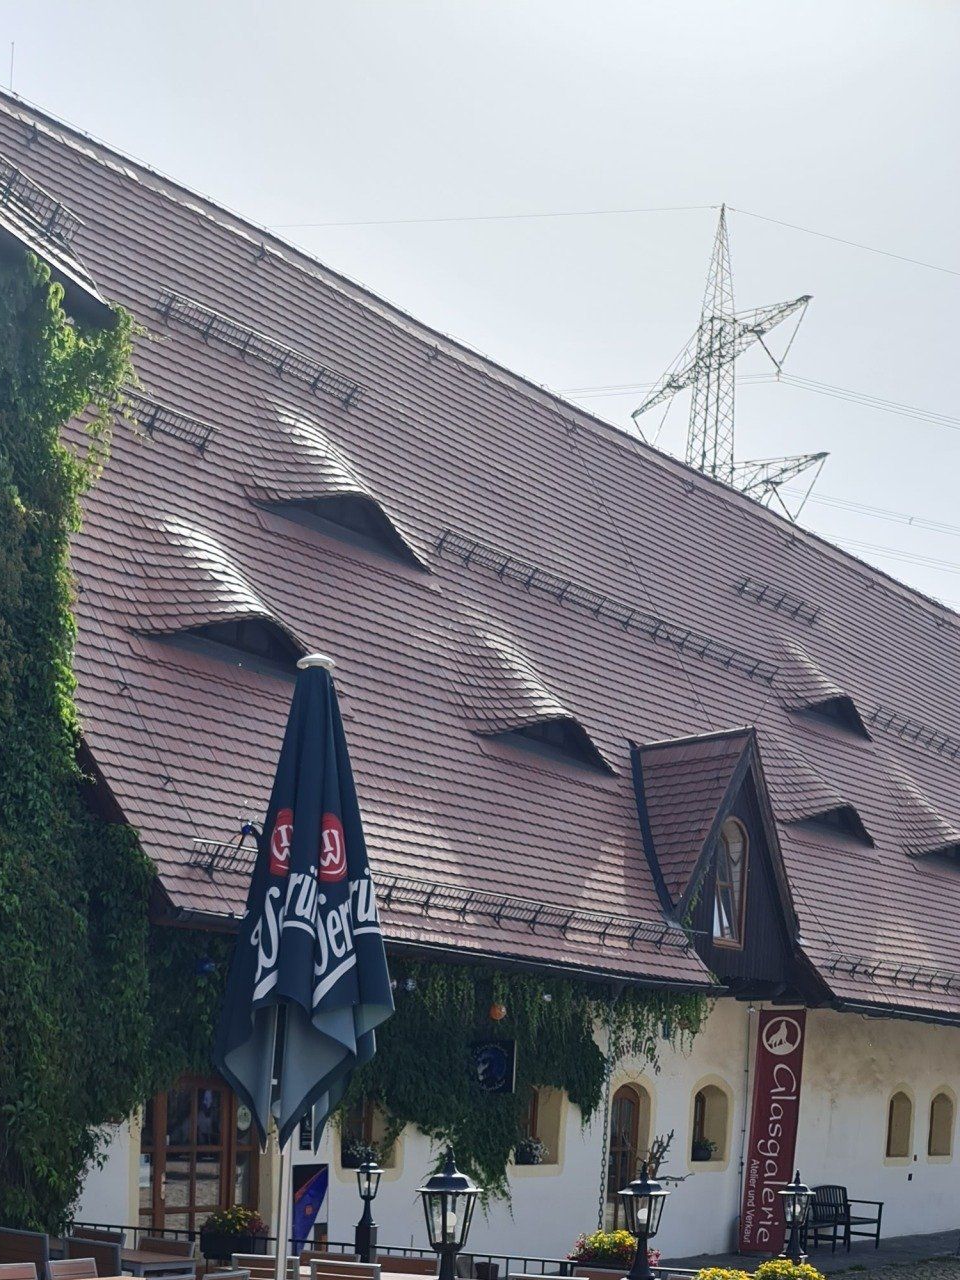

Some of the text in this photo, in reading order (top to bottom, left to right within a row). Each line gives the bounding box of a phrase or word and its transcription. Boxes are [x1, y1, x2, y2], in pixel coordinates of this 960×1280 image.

[743, 1159, 760, 1244] Atelier und Verkauf
[756, 1063, 797, 1244] Glasgalerie
